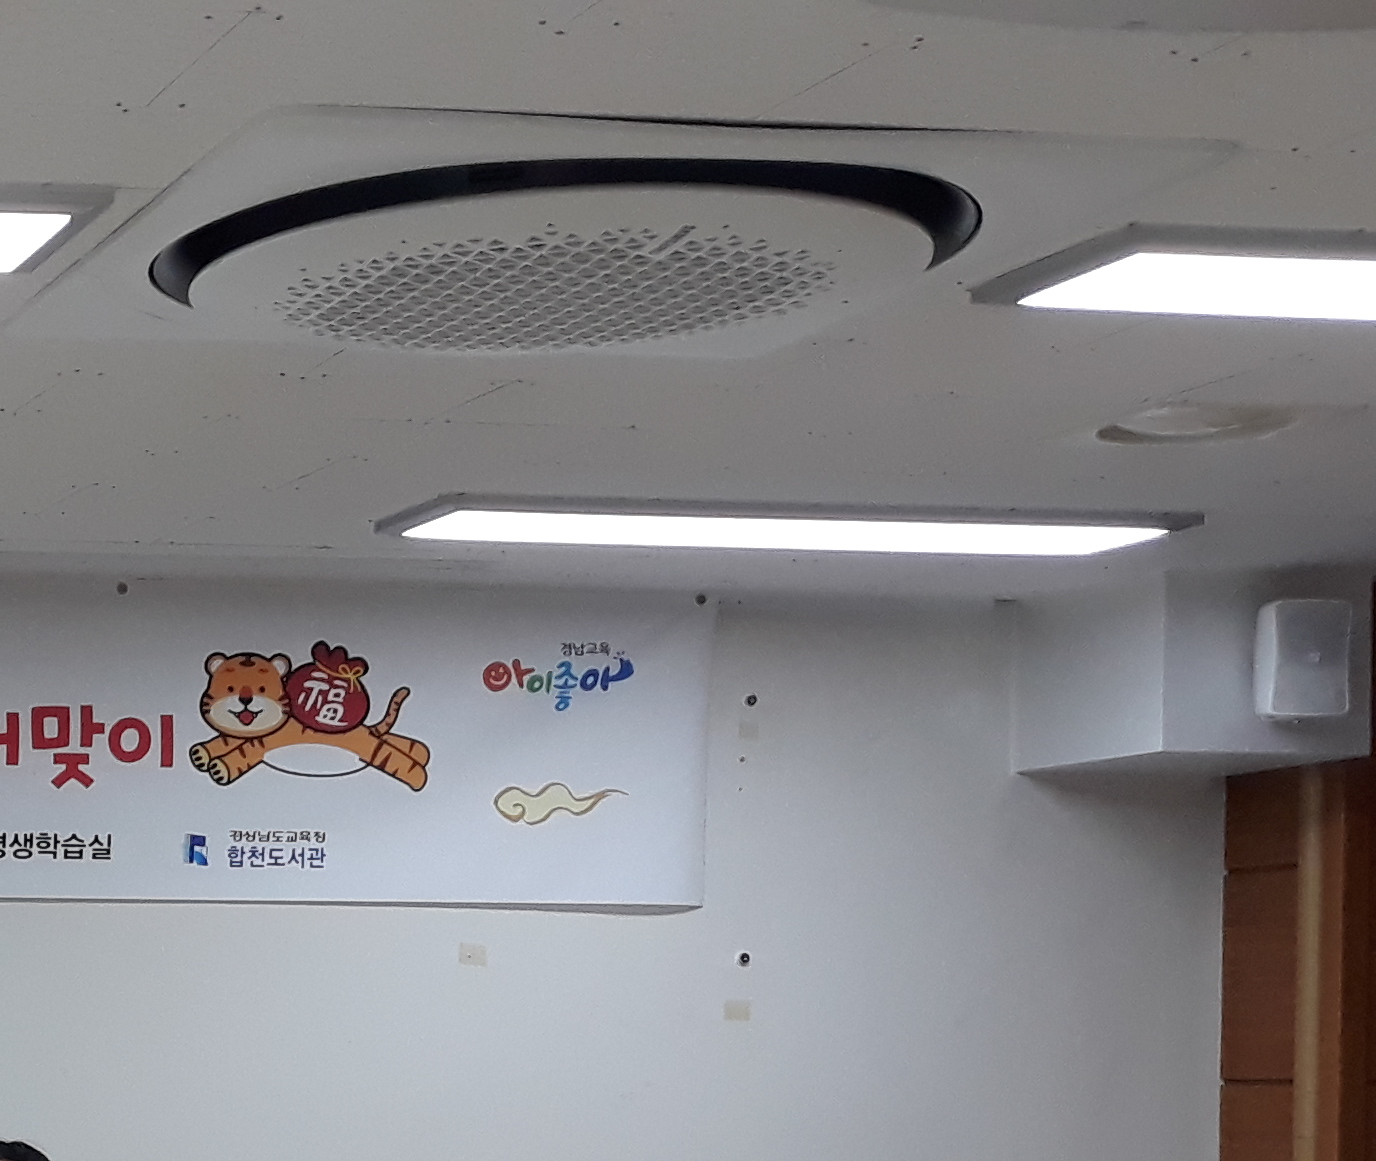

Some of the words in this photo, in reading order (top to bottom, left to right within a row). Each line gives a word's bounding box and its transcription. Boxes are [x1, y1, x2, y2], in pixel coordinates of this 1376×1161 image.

[561, 641, 612, 656] 경남교육
[483, 658, 634, 711] 아이좋아
[297, 671, 349, 726] 福
[229, 830, 326, 843] 경상남도교육청
[227, 846, 326, 868] 합천도서관
